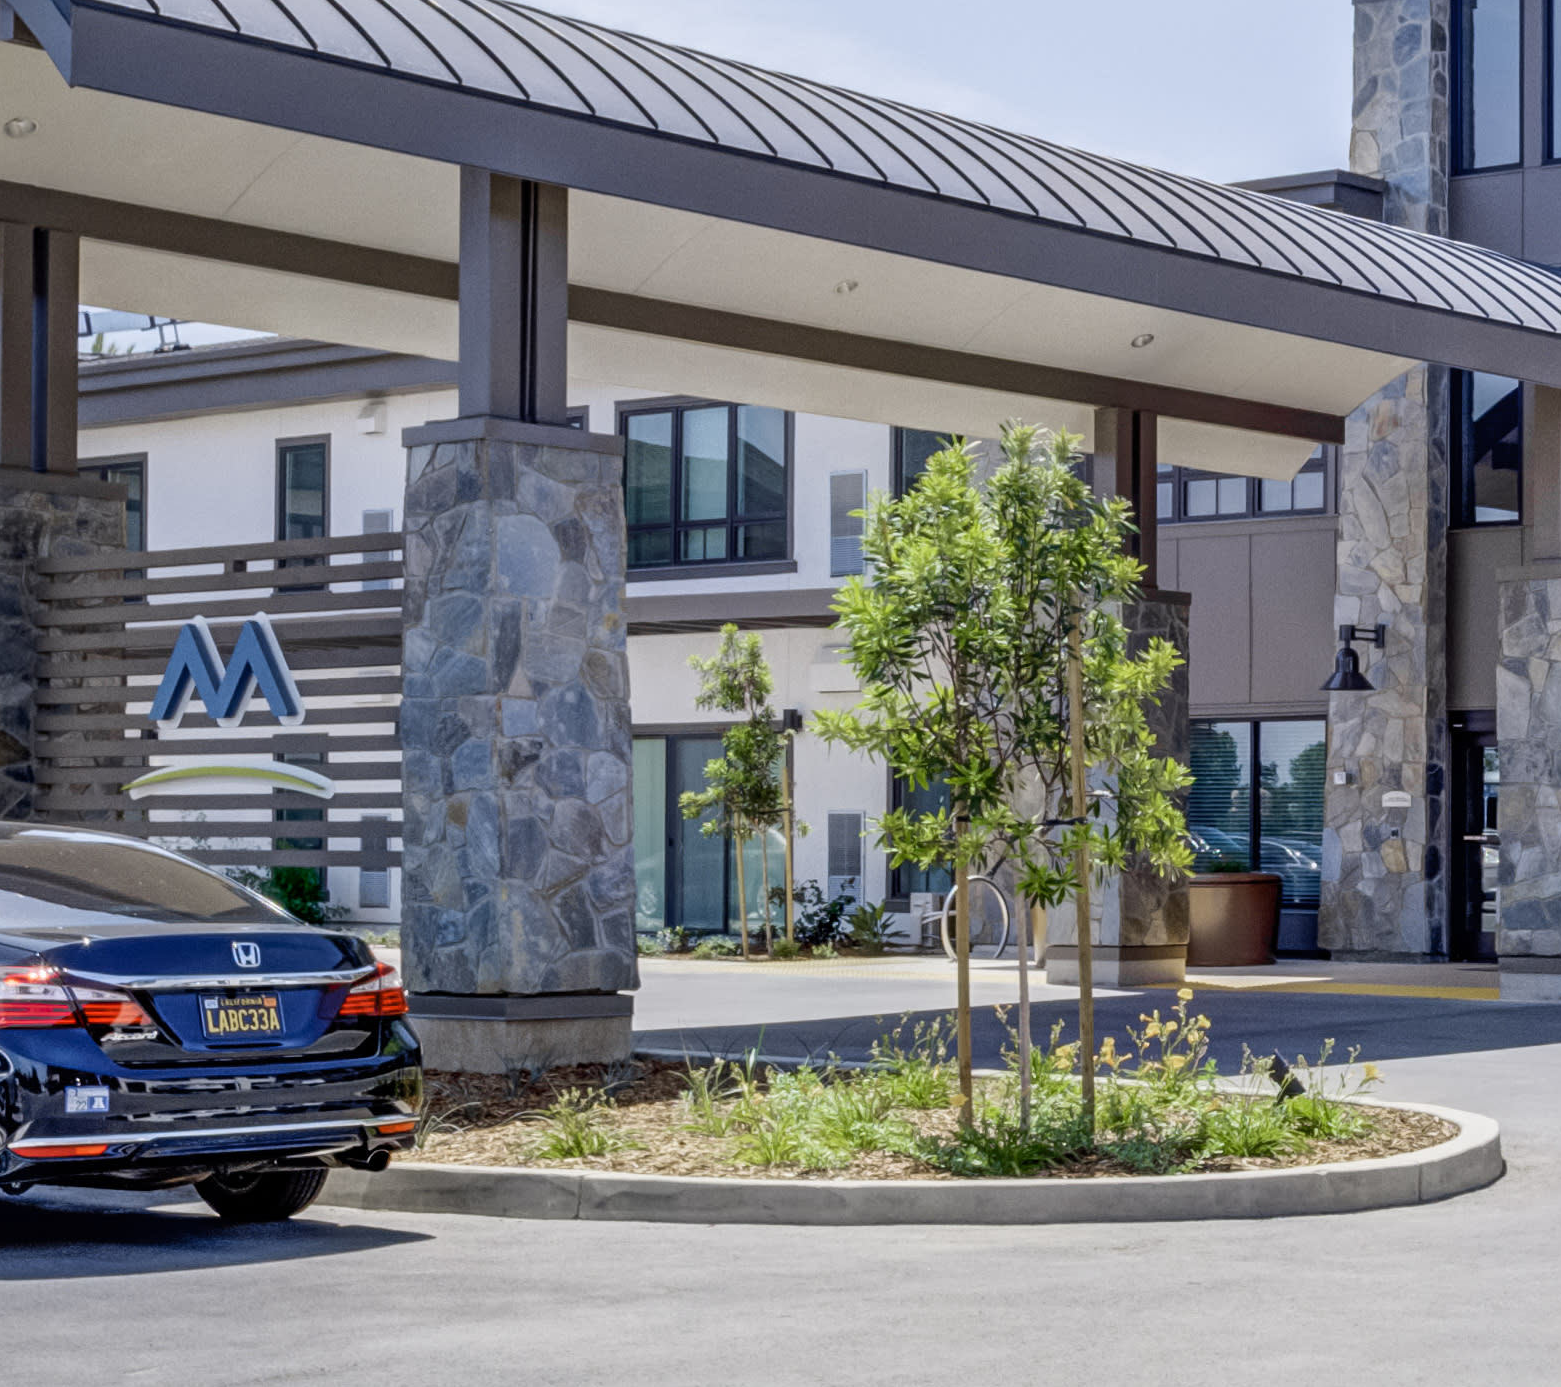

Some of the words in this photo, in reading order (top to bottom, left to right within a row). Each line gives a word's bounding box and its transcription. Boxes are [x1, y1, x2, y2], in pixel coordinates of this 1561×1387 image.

[220, 997, 263, 1007] CALIFORNIA
[206, 1008, 280, 1033] LABC33A
[100, 1030, 158, 1042] Accord
